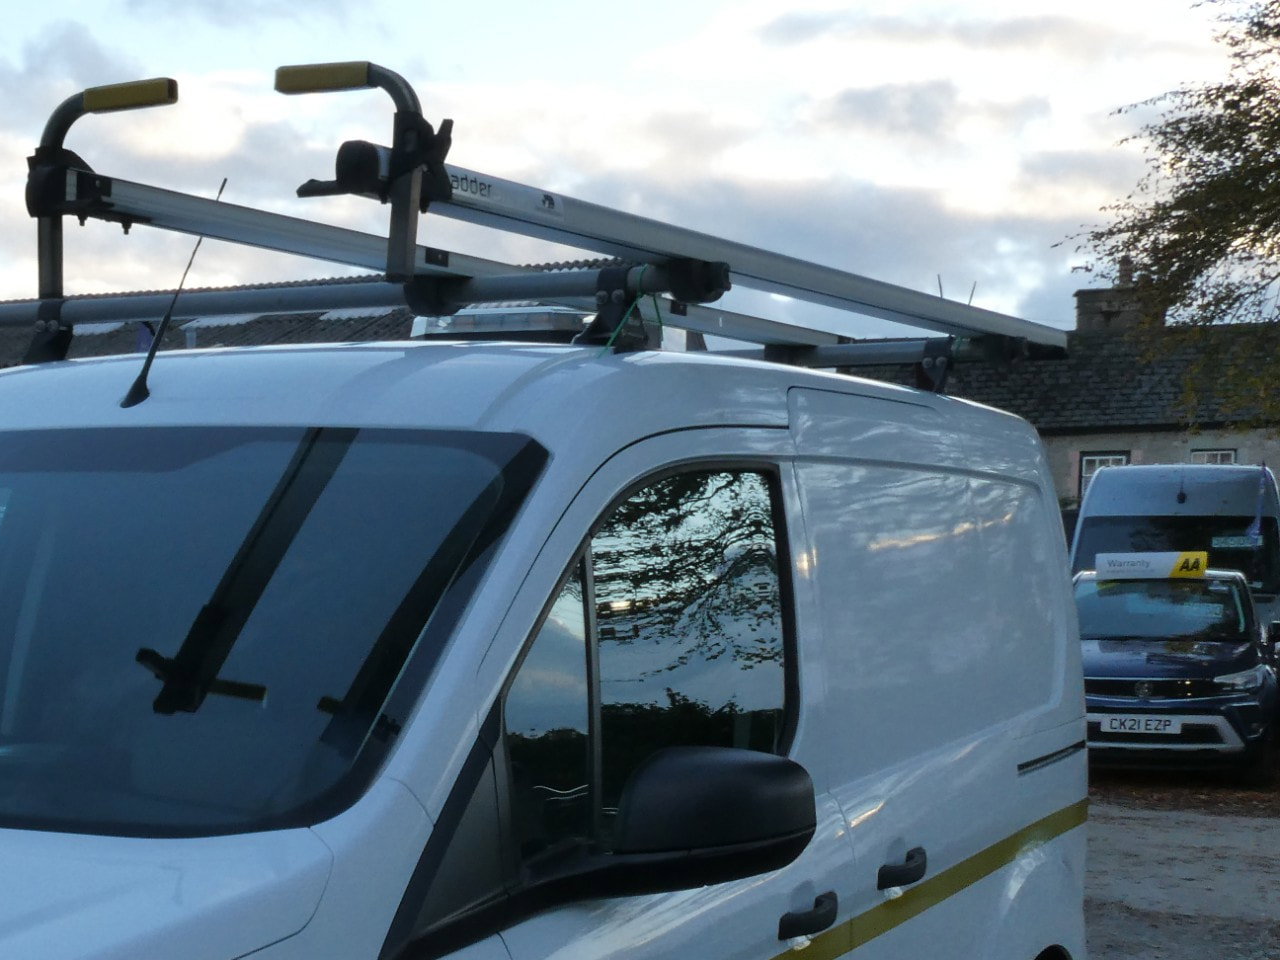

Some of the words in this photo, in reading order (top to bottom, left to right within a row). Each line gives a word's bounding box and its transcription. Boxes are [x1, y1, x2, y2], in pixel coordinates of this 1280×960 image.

[1106, 559, 1151, 569] Warranty
[1179, 557, 1201, 572] AA
[1110, 718, 1140, 731] CK21
[1144, 719, 1172, 732] EZP
